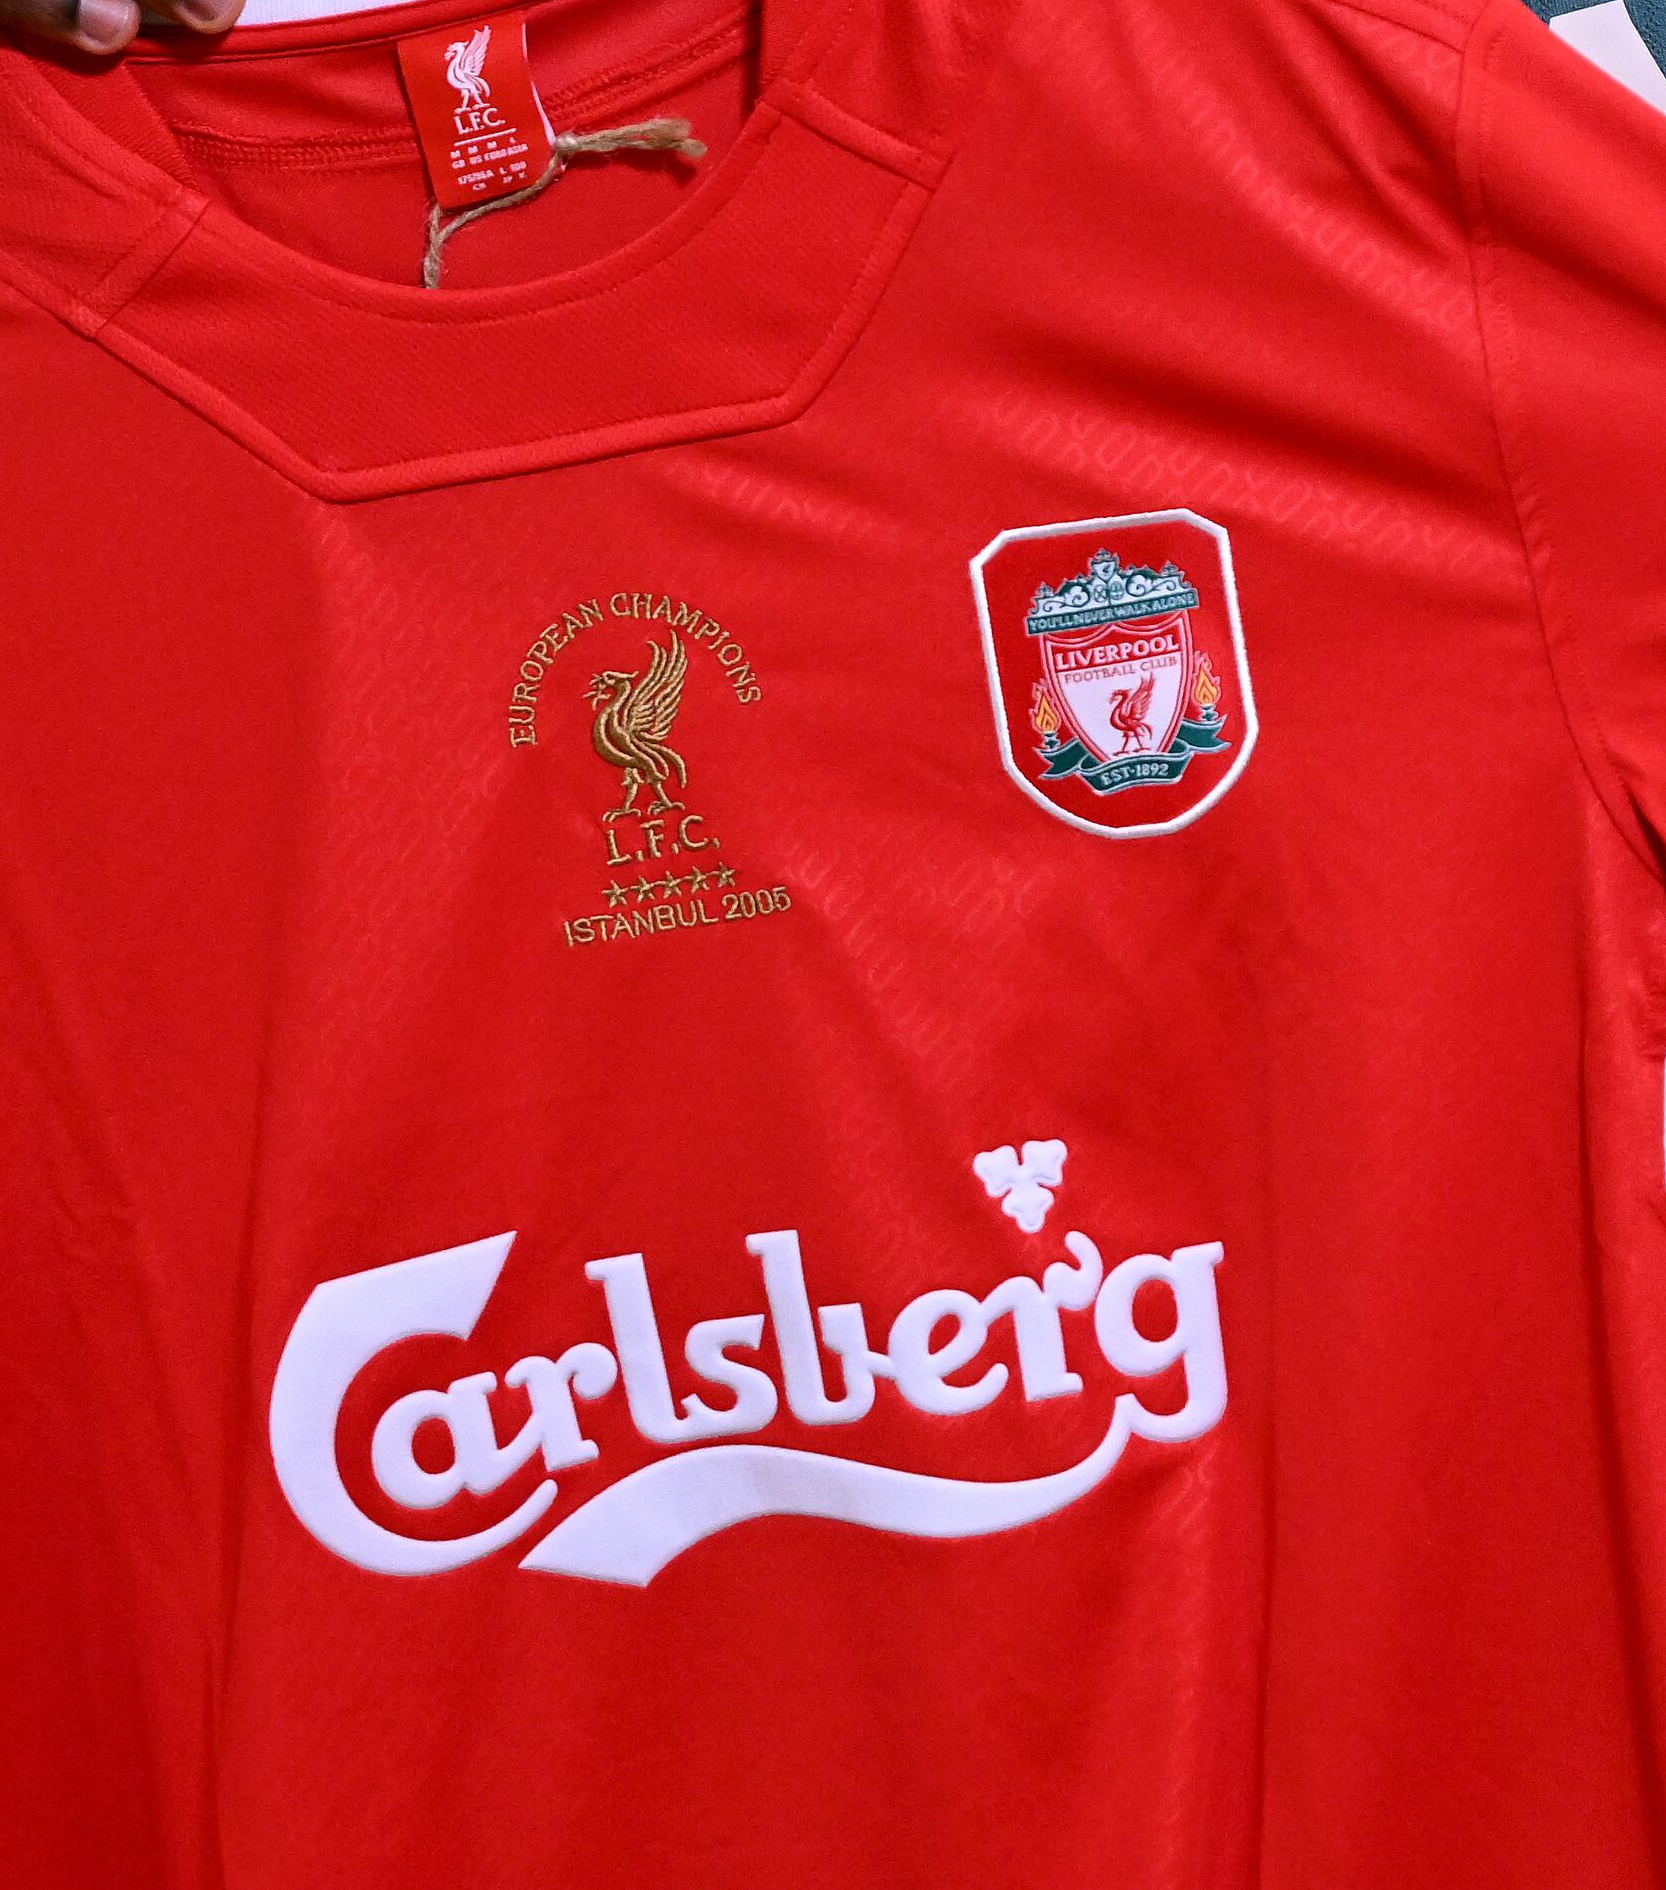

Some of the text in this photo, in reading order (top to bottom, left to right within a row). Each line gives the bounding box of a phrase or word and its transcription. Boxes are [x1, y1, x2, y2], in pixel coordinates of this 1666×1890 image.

[453, 107, 506, 135] L.F.C.
[1152, 592, 1194, 611] ALONE
[507, 592, 763, 749] EUROPEAN CHAMPIONS
[1053, 633, 1180, 671] LIVERPOOL
[1063, 656, 1178, 685] FOOTBALL CLUB
[605, 814, 721, 867] L.F.C.
[562, 886, 792, 947] ISTANBUL 2005
[269, 1229, 1228, 1588] Carlsberg
